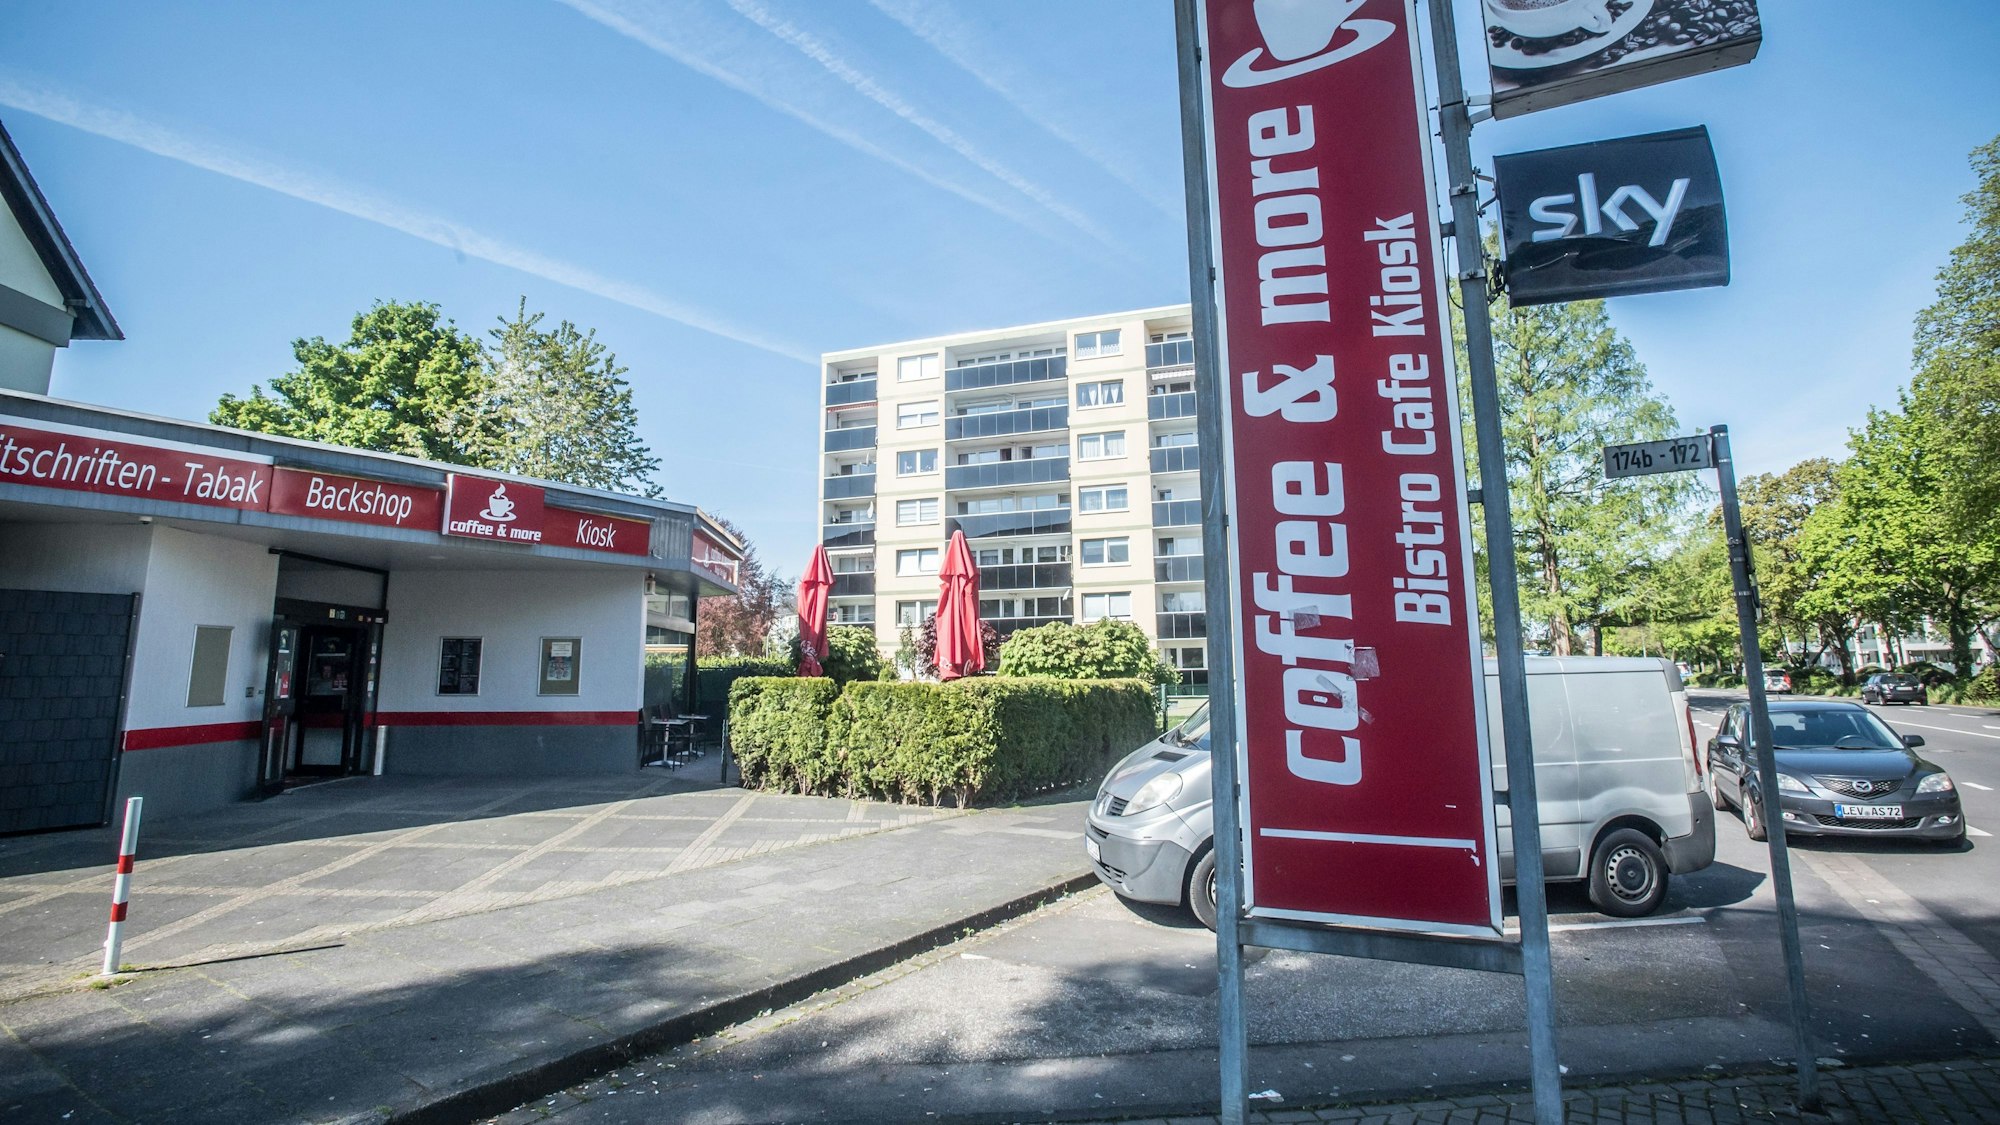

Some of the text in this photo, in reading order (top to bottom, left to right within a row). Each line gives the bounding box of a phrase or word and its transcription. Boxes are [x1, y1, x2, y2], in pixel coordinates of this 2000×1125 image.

[1528, 172, 1691, 248] sky
[1363, 211, 1452, 627] Bistro Cafe Kiosk
[1241, 104, 1363, 786] coffee & more
[1612, 449, 1653, 471] 174b
[1668, 443, 1701, 465] 172
[183, 462, 264, 504] Tabak
[305, 476, 413, 525] Backshop
[450, 519, 542, 542] coffee & more
[575, 518, 617, 548] Kiosk
[1842, 806, 1901, 816] LEV AS 72
